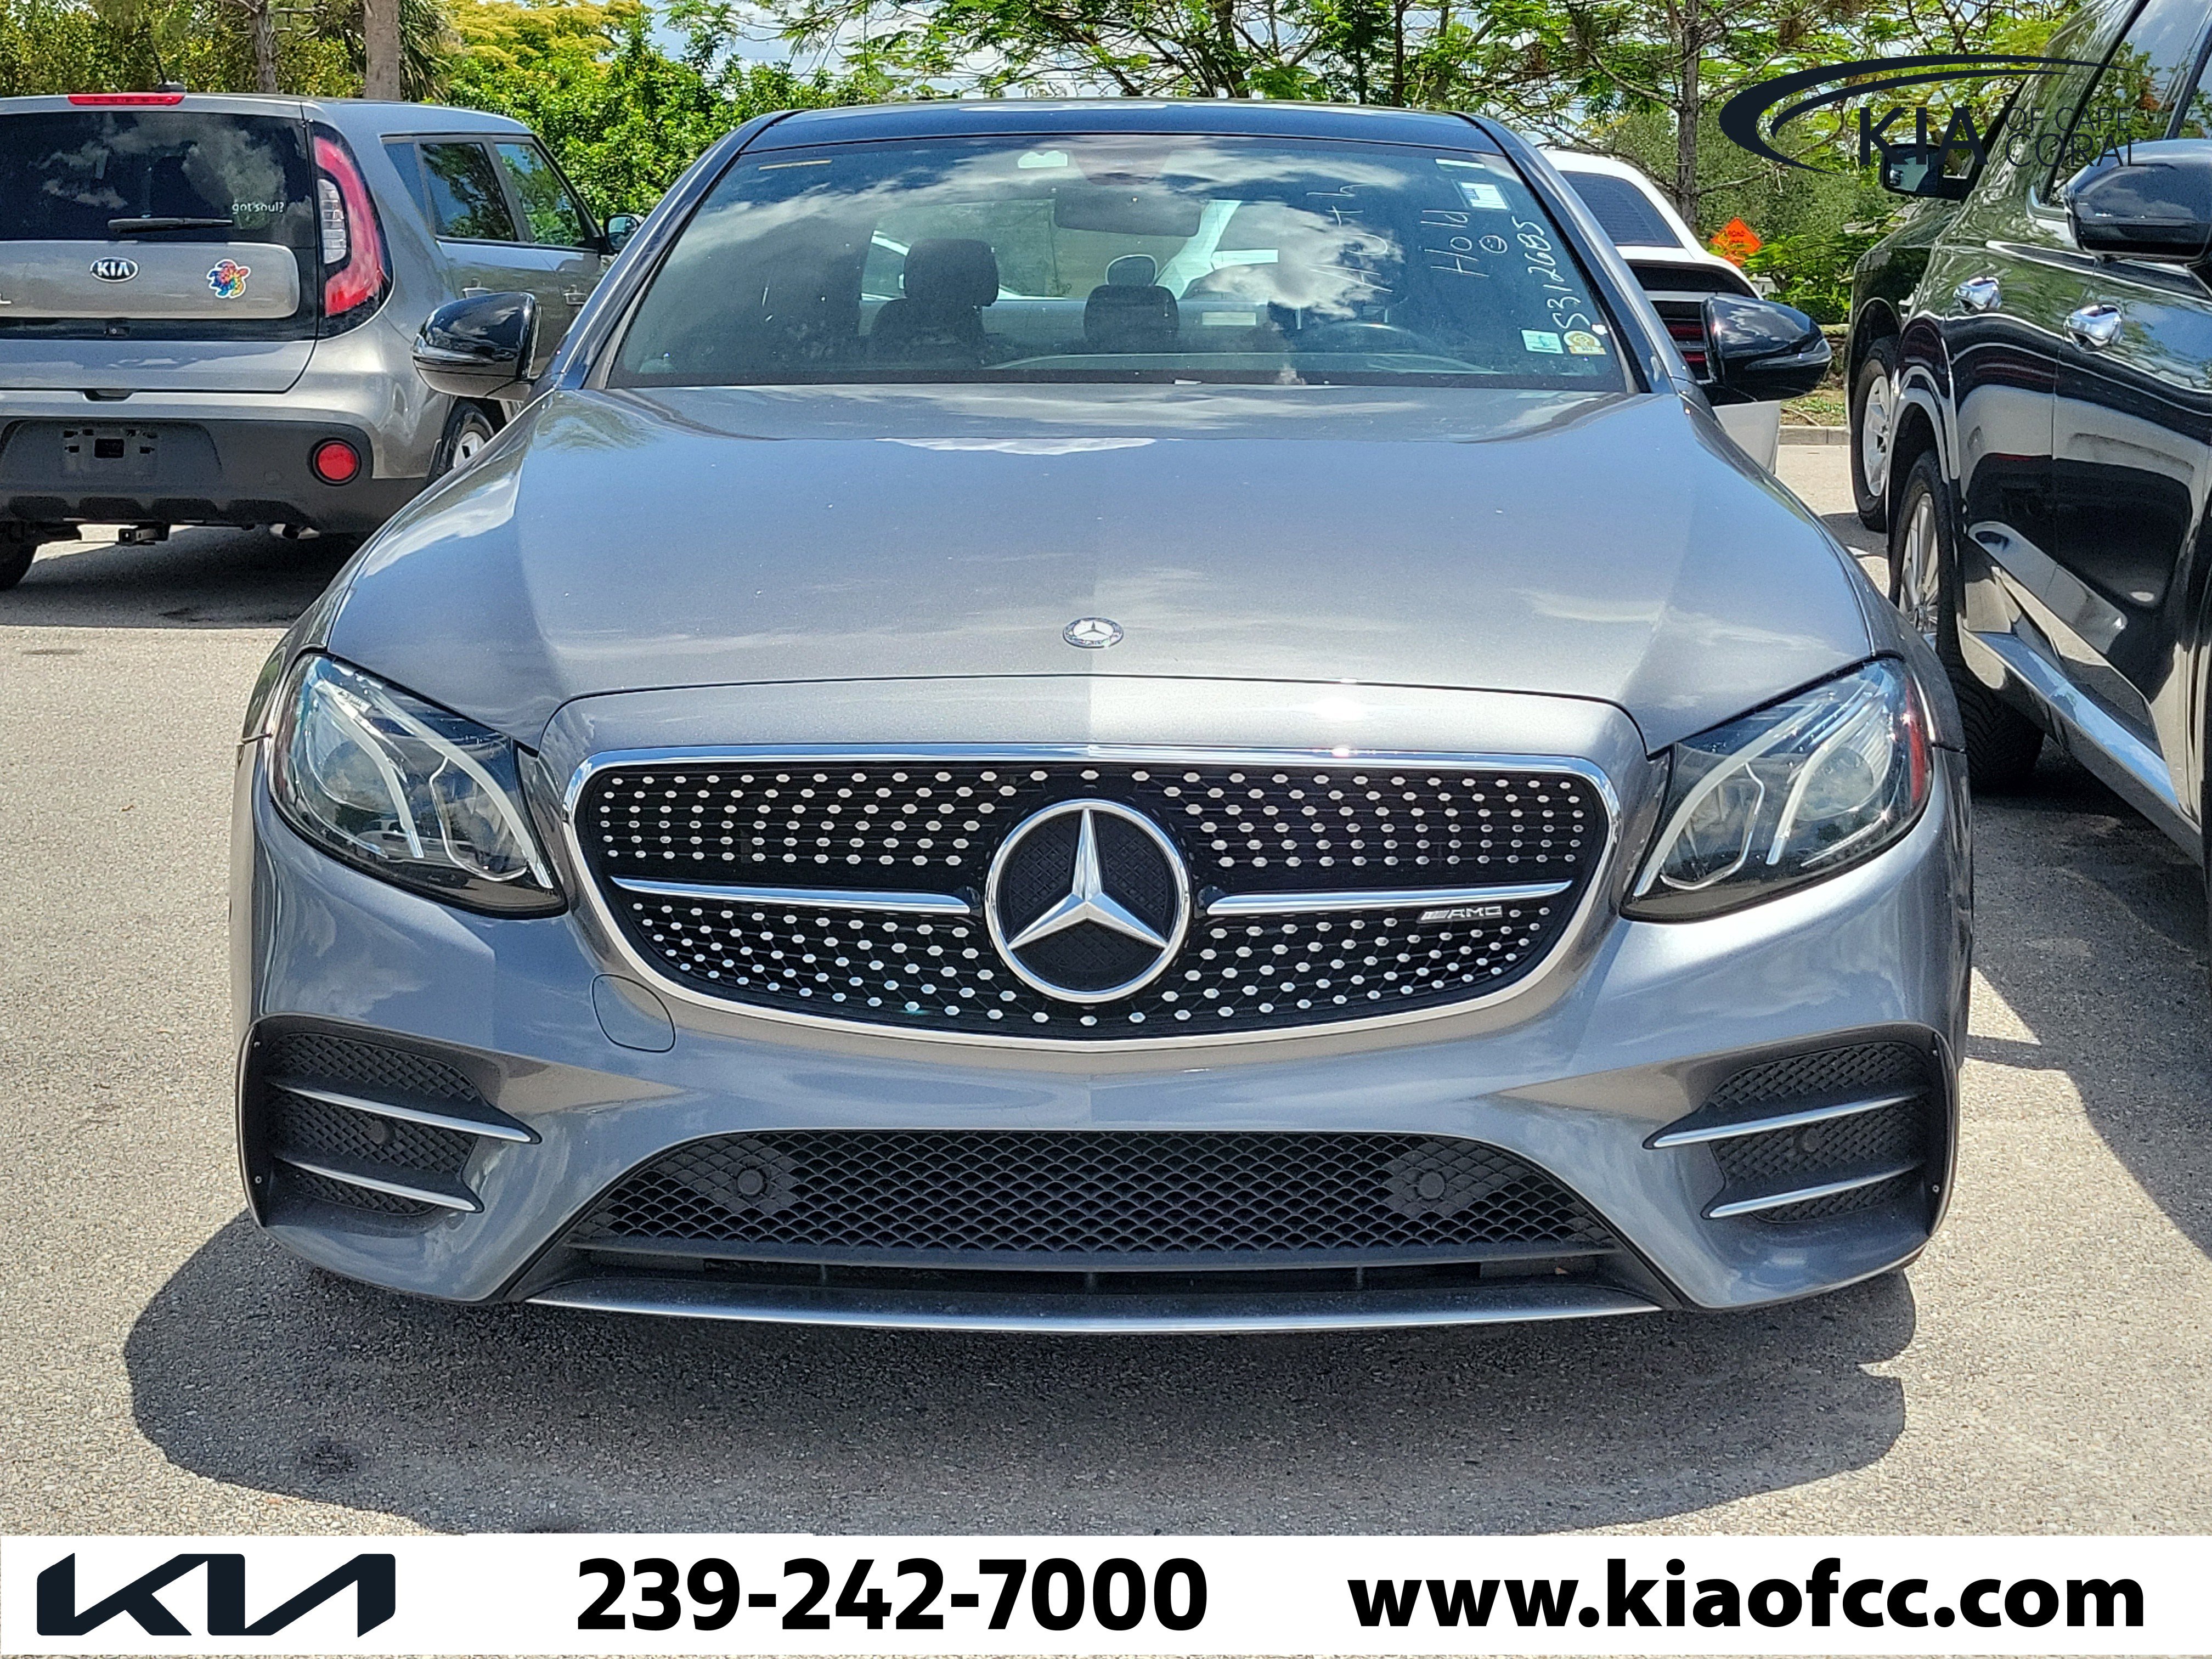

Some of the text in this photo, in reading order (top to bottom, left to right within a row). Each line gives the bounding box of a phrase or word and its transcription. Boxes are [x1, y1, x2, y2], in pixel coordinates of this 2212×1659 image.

[232, 201, 285, 215] got soul?
[1420, 210, 1489, 278] Hold
[97, 261, 131, 276] KIA
[1447, 905, 1503, 919] AMG
